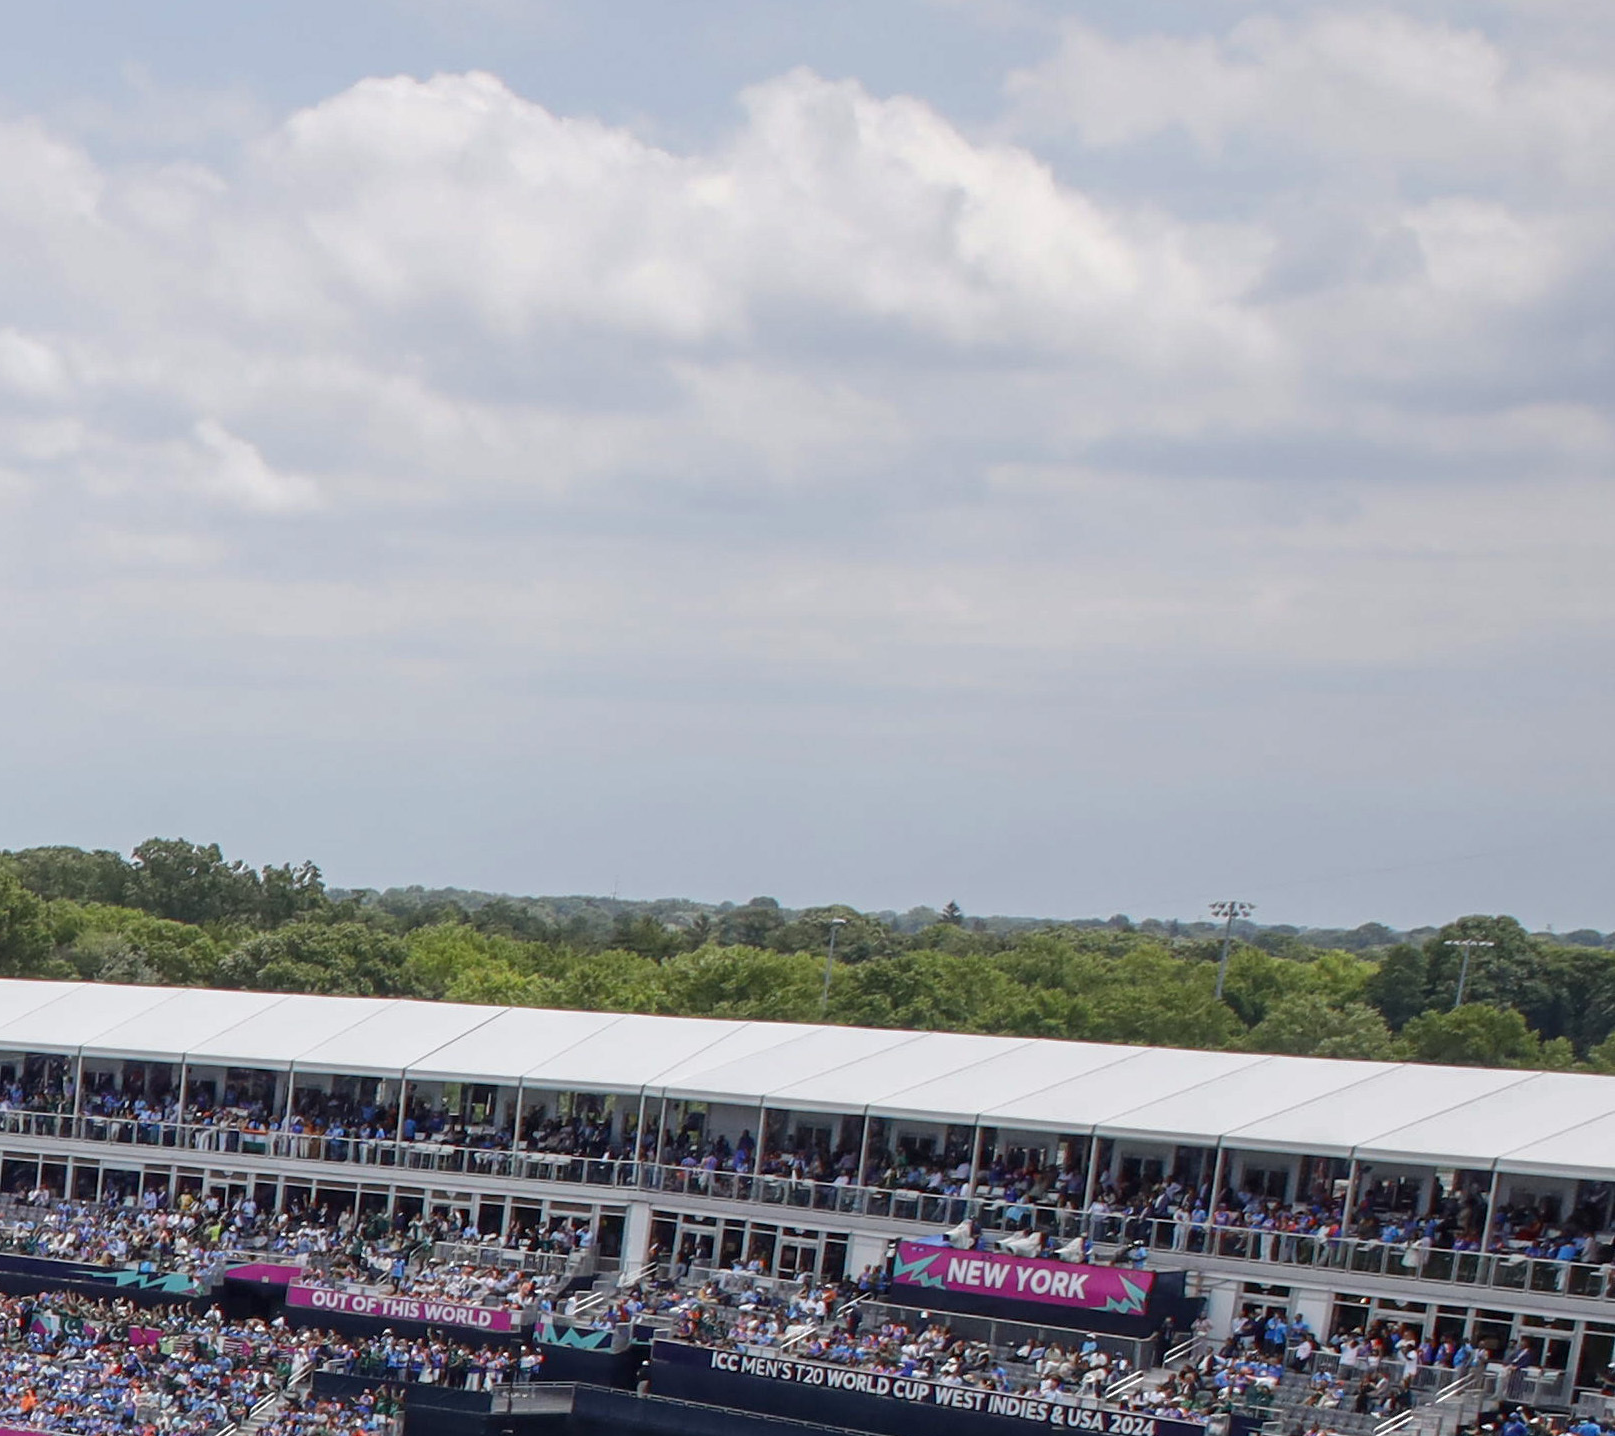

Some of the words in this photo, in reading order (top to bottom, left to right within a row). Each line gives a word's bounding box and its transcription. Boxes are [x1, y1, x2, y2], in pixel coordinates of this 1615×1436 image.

[946, 1257, 1012, 1290] NEW
[1015, 1266, 1089, 1300] YORK
[311, 1291, 348, 1310] OUT
[351, 1296, 377, 1312] OF
[380, 1299, 420, 1318] THIS
[424, 1303, 492, 1328] WORLD
[711, 1351, 738, 1372] ICC
[740, 1356, 791, 1381] MEN'S
[795, 1363, 823, 1385] T20
[826, 1369, 889, 1396] WORLD
[892, 1380, 929, 1401] CUP
[934, 1385, 985, 1412] WEST
[987, 1395, 1048, 1422] INDIES
[1049, 1408, 1064, 1425] &
[1066, 1407, 1104, 1431] USA
